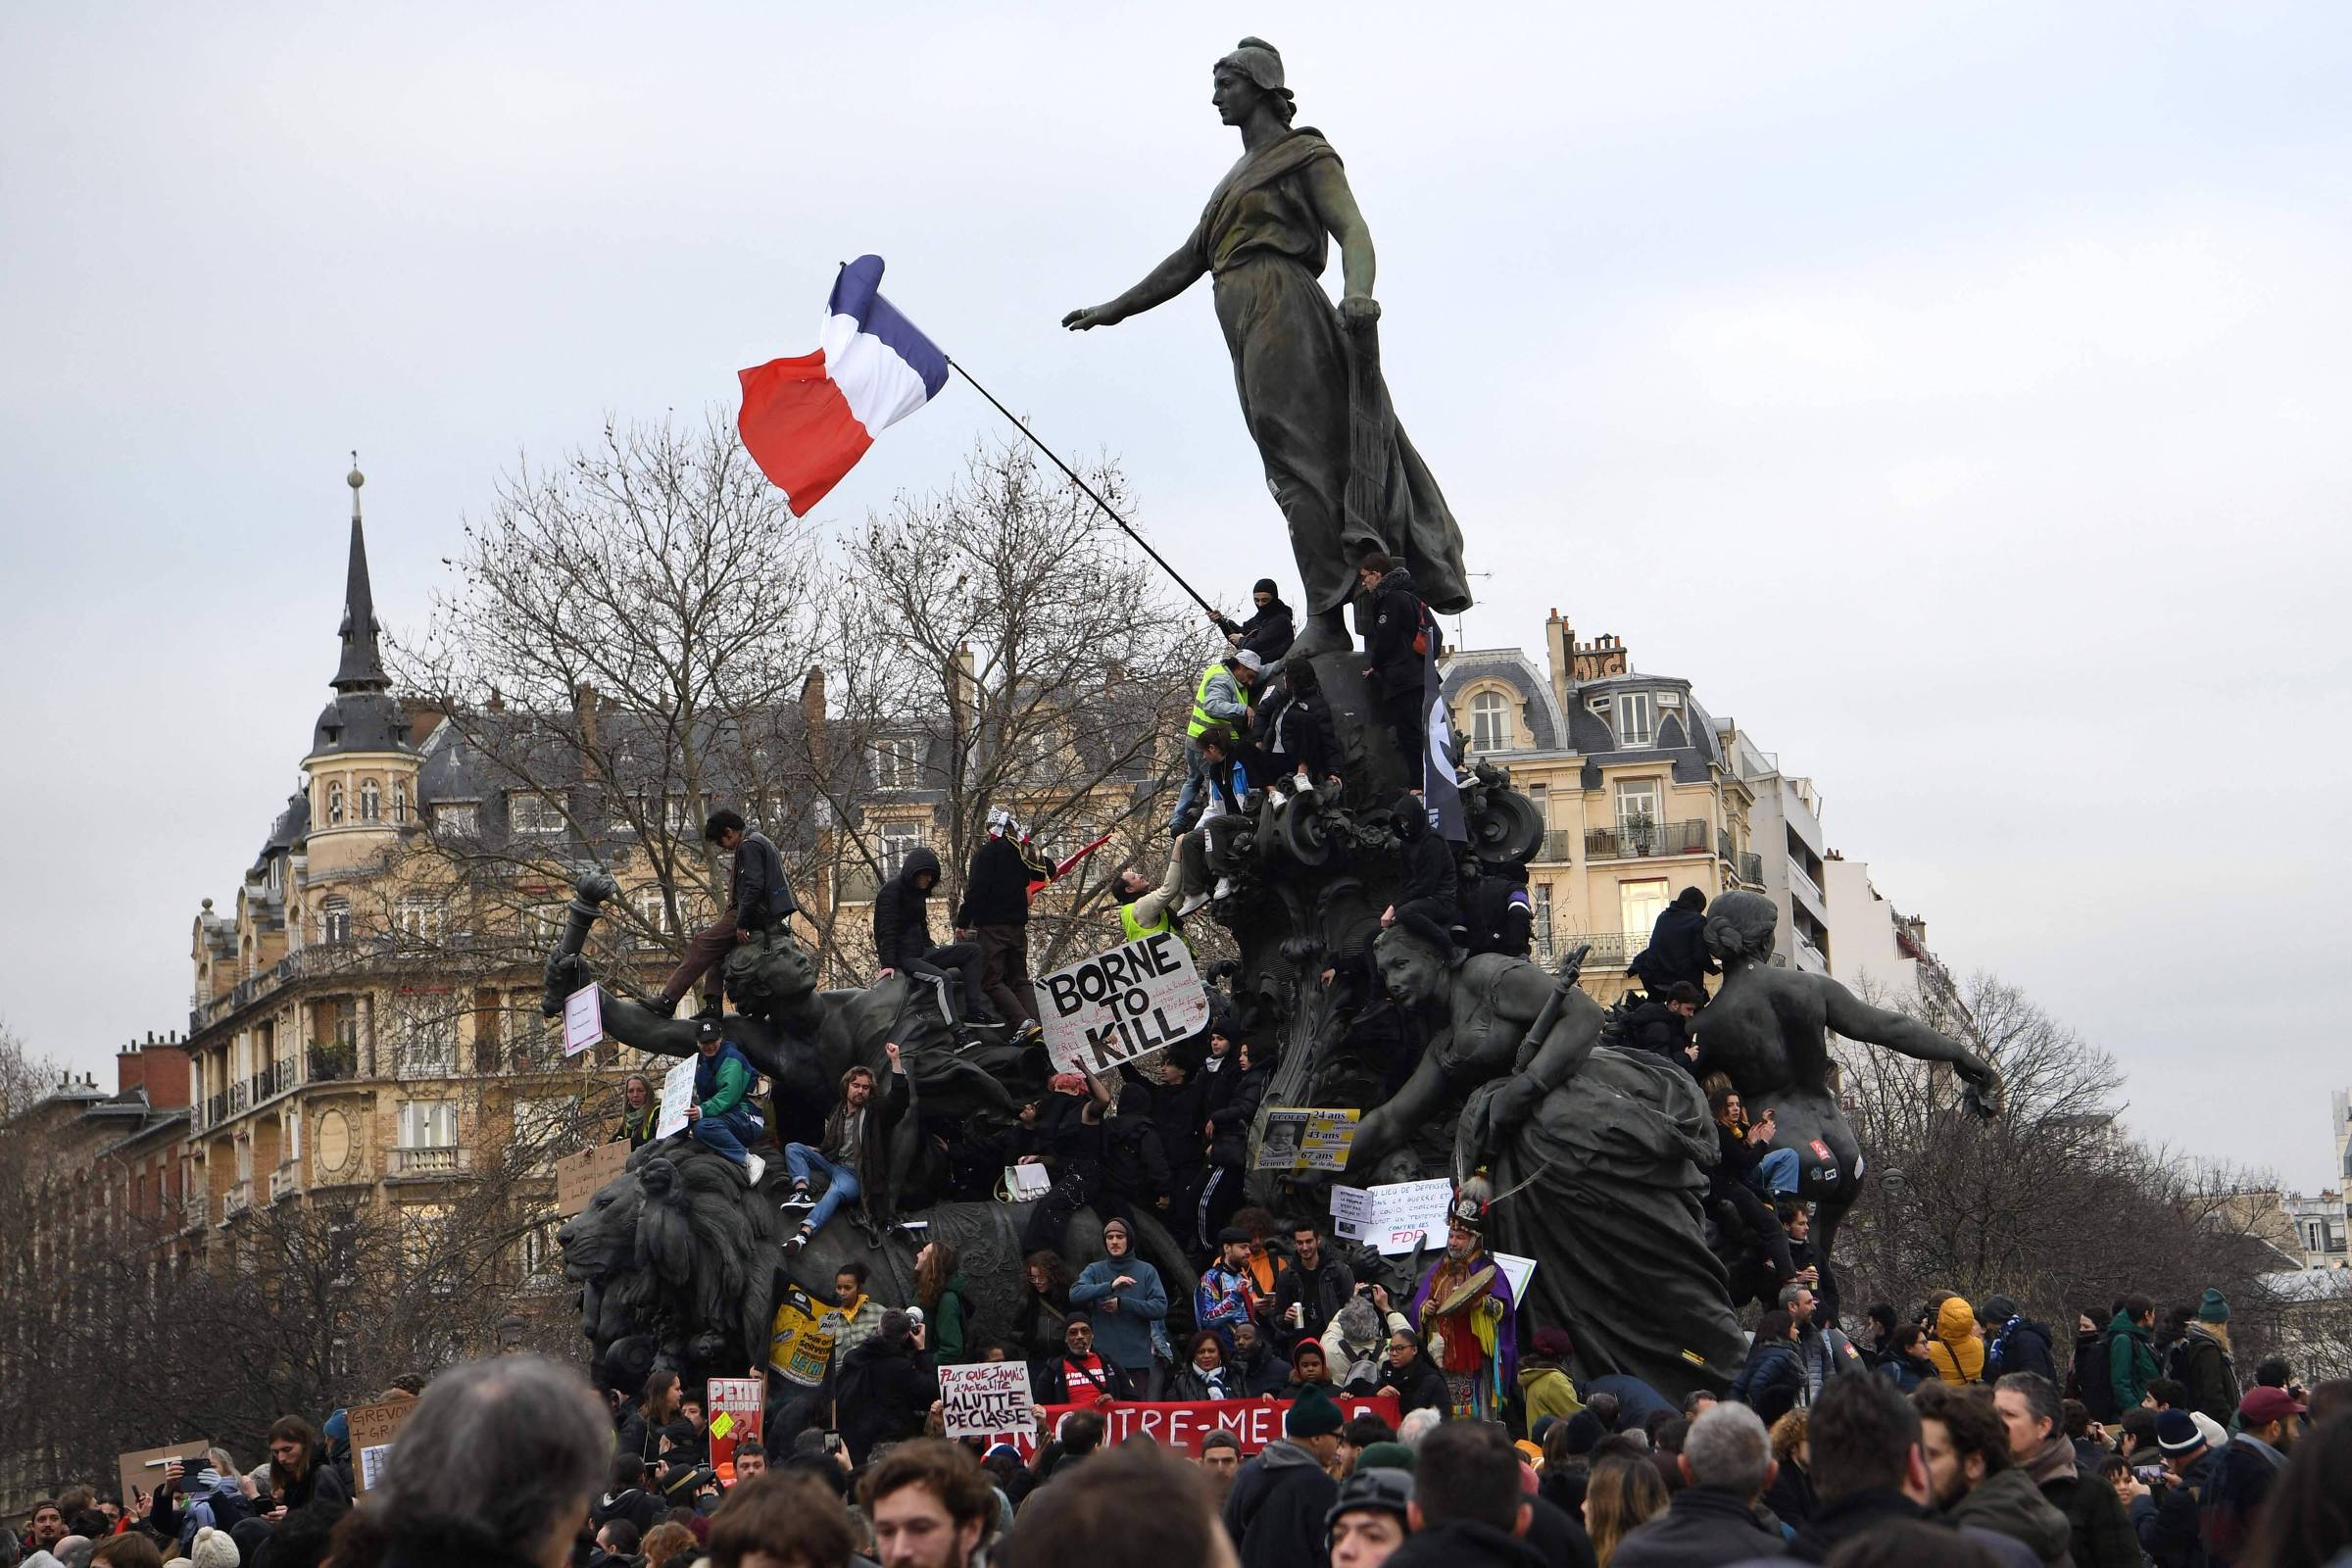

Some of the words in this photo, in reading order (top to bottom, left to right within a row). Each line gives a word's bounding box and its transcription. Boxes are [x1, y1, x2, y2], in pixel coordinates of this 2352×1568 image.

[1099, 988, 1150, 1022] TO
[1085, 1007, 1188, 1069] KILL
[940, 1368, 963, 1385] PLUS
[965, 1368, 990, 1382] QUE
[710, 1381, 760, 1401] PETIT
